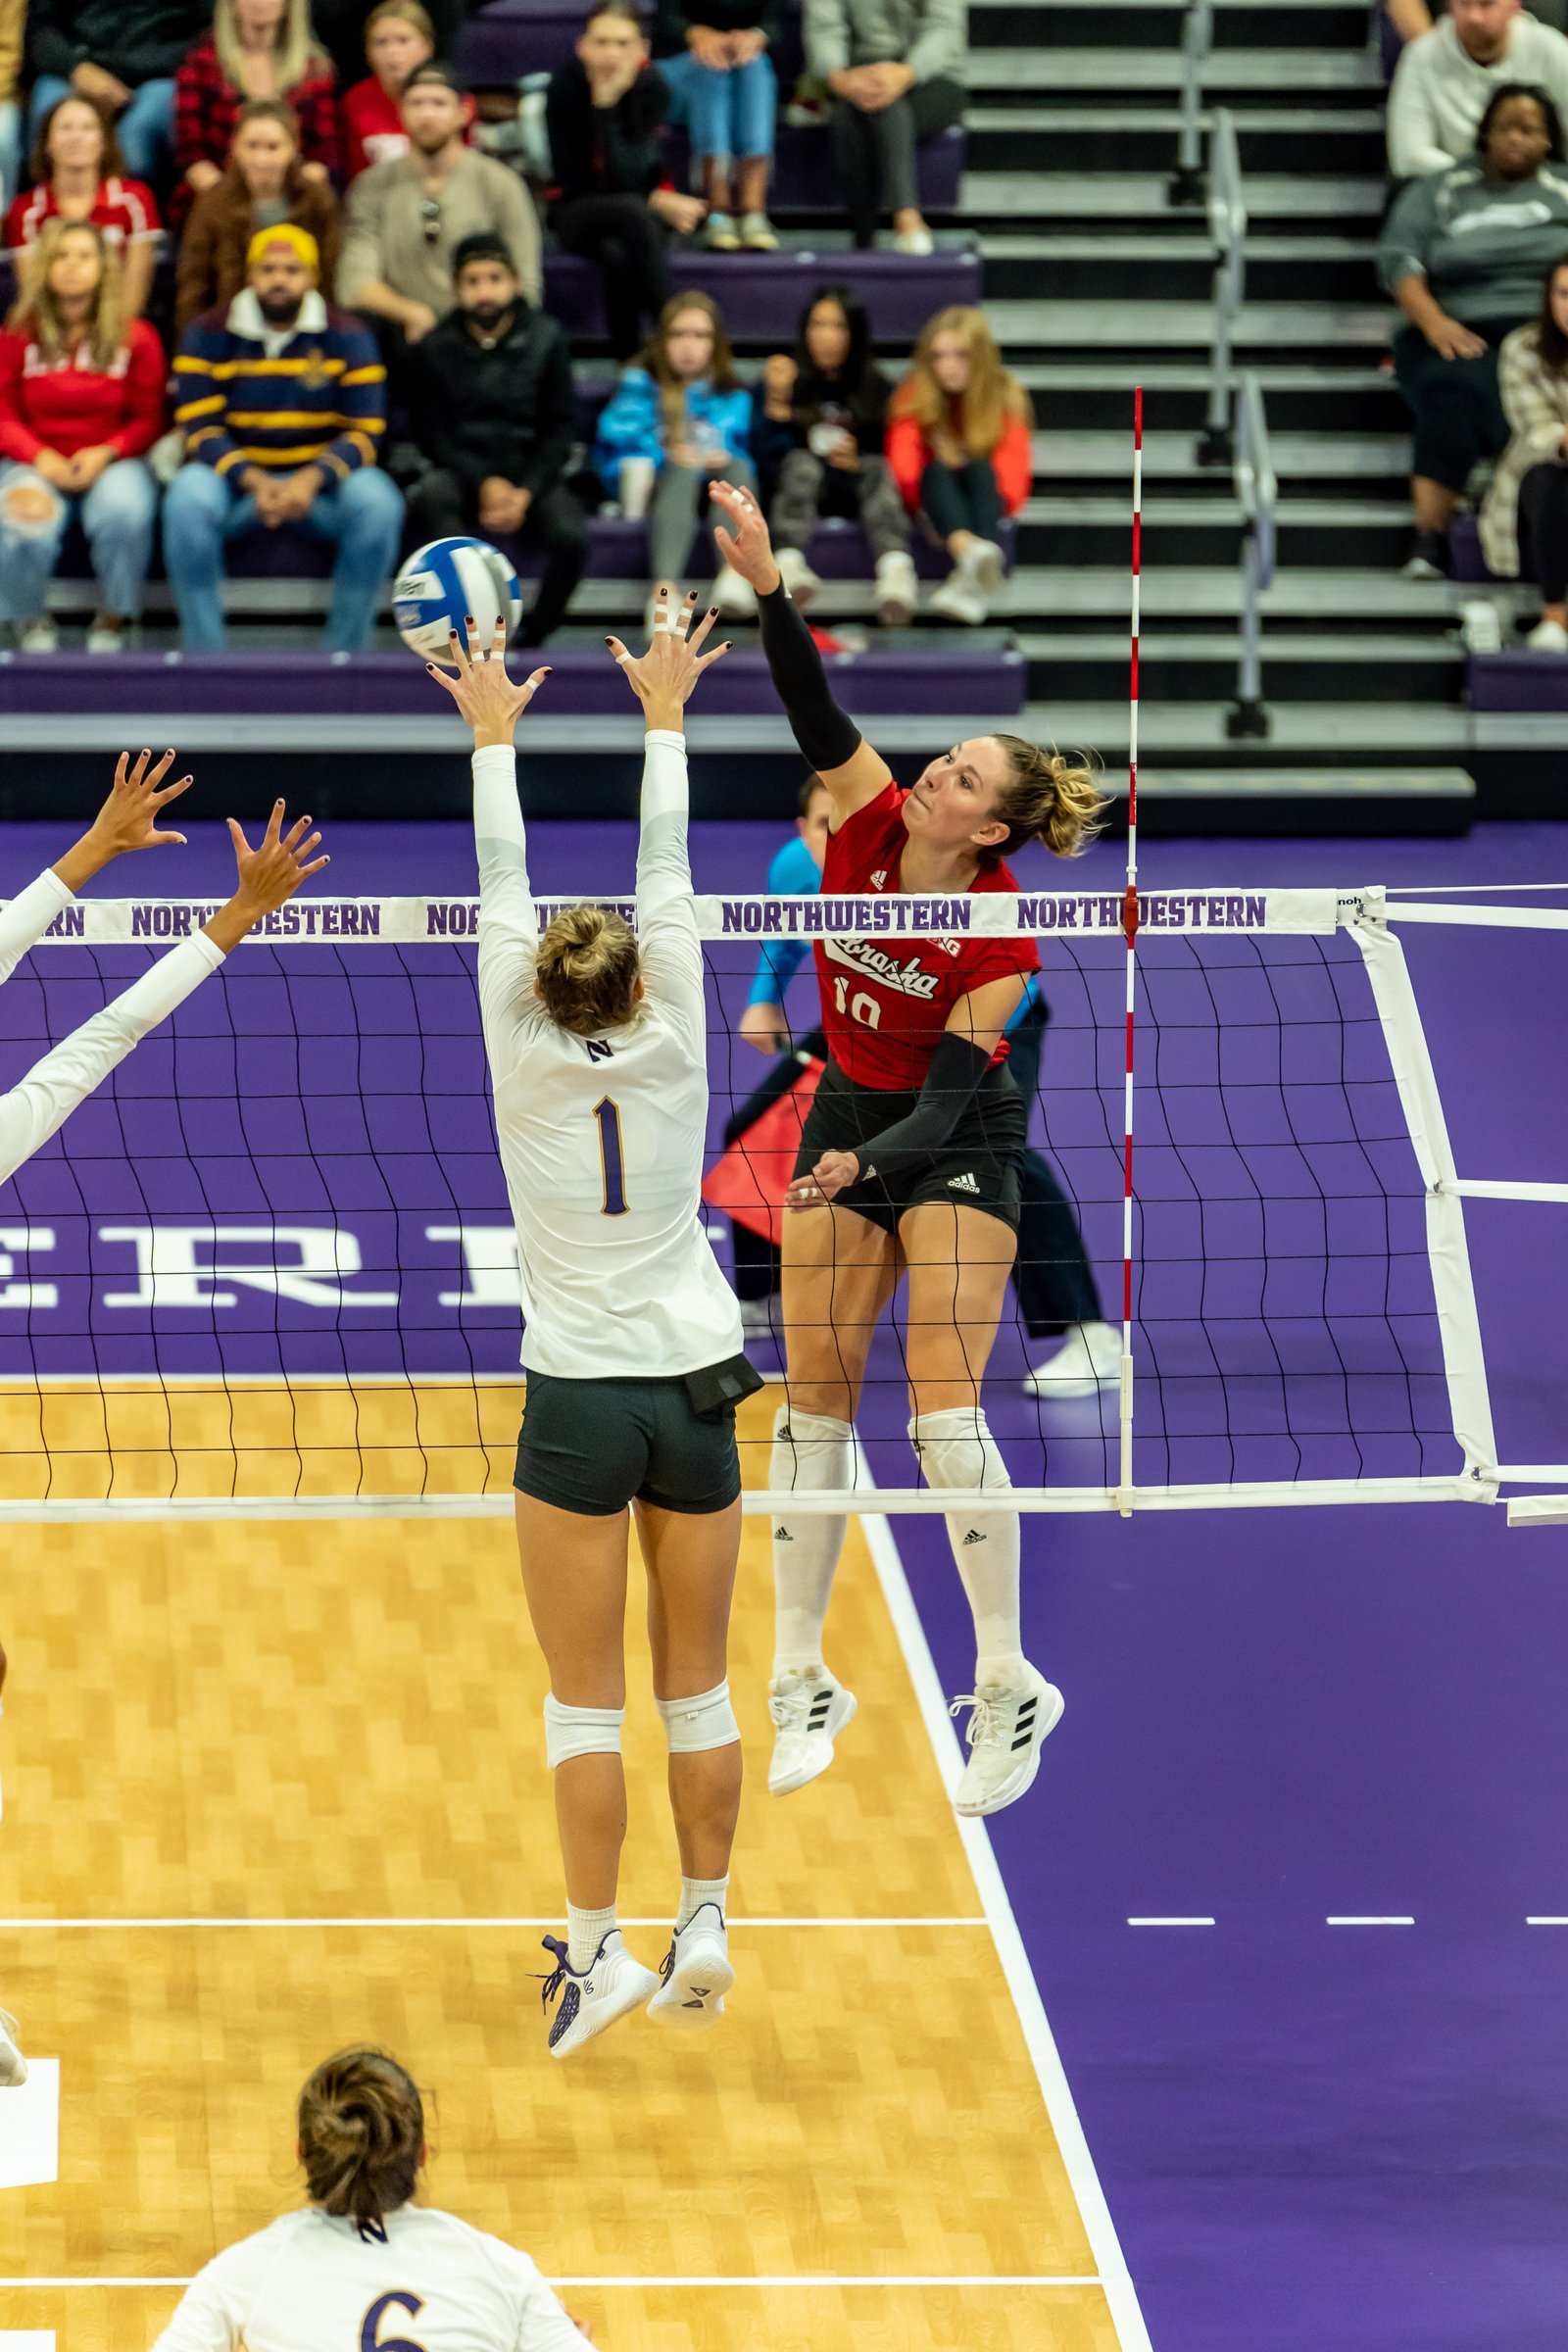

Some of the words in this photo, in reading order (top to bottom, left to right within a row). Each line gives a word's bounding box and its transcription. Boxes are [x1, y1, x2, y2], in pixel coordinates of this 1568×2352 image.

[131, 905, 380, 936] NORTESTERN
[721, 900, 971, 933] NORTHWESTERN
[825, 938, 939, 999] braska
[833, 976, 881, 1030] 10
[586, 1039, 613, 1062] N
[592, 1095, 630, 1217] 1
[947, 1180, 981, 1194] adidas
